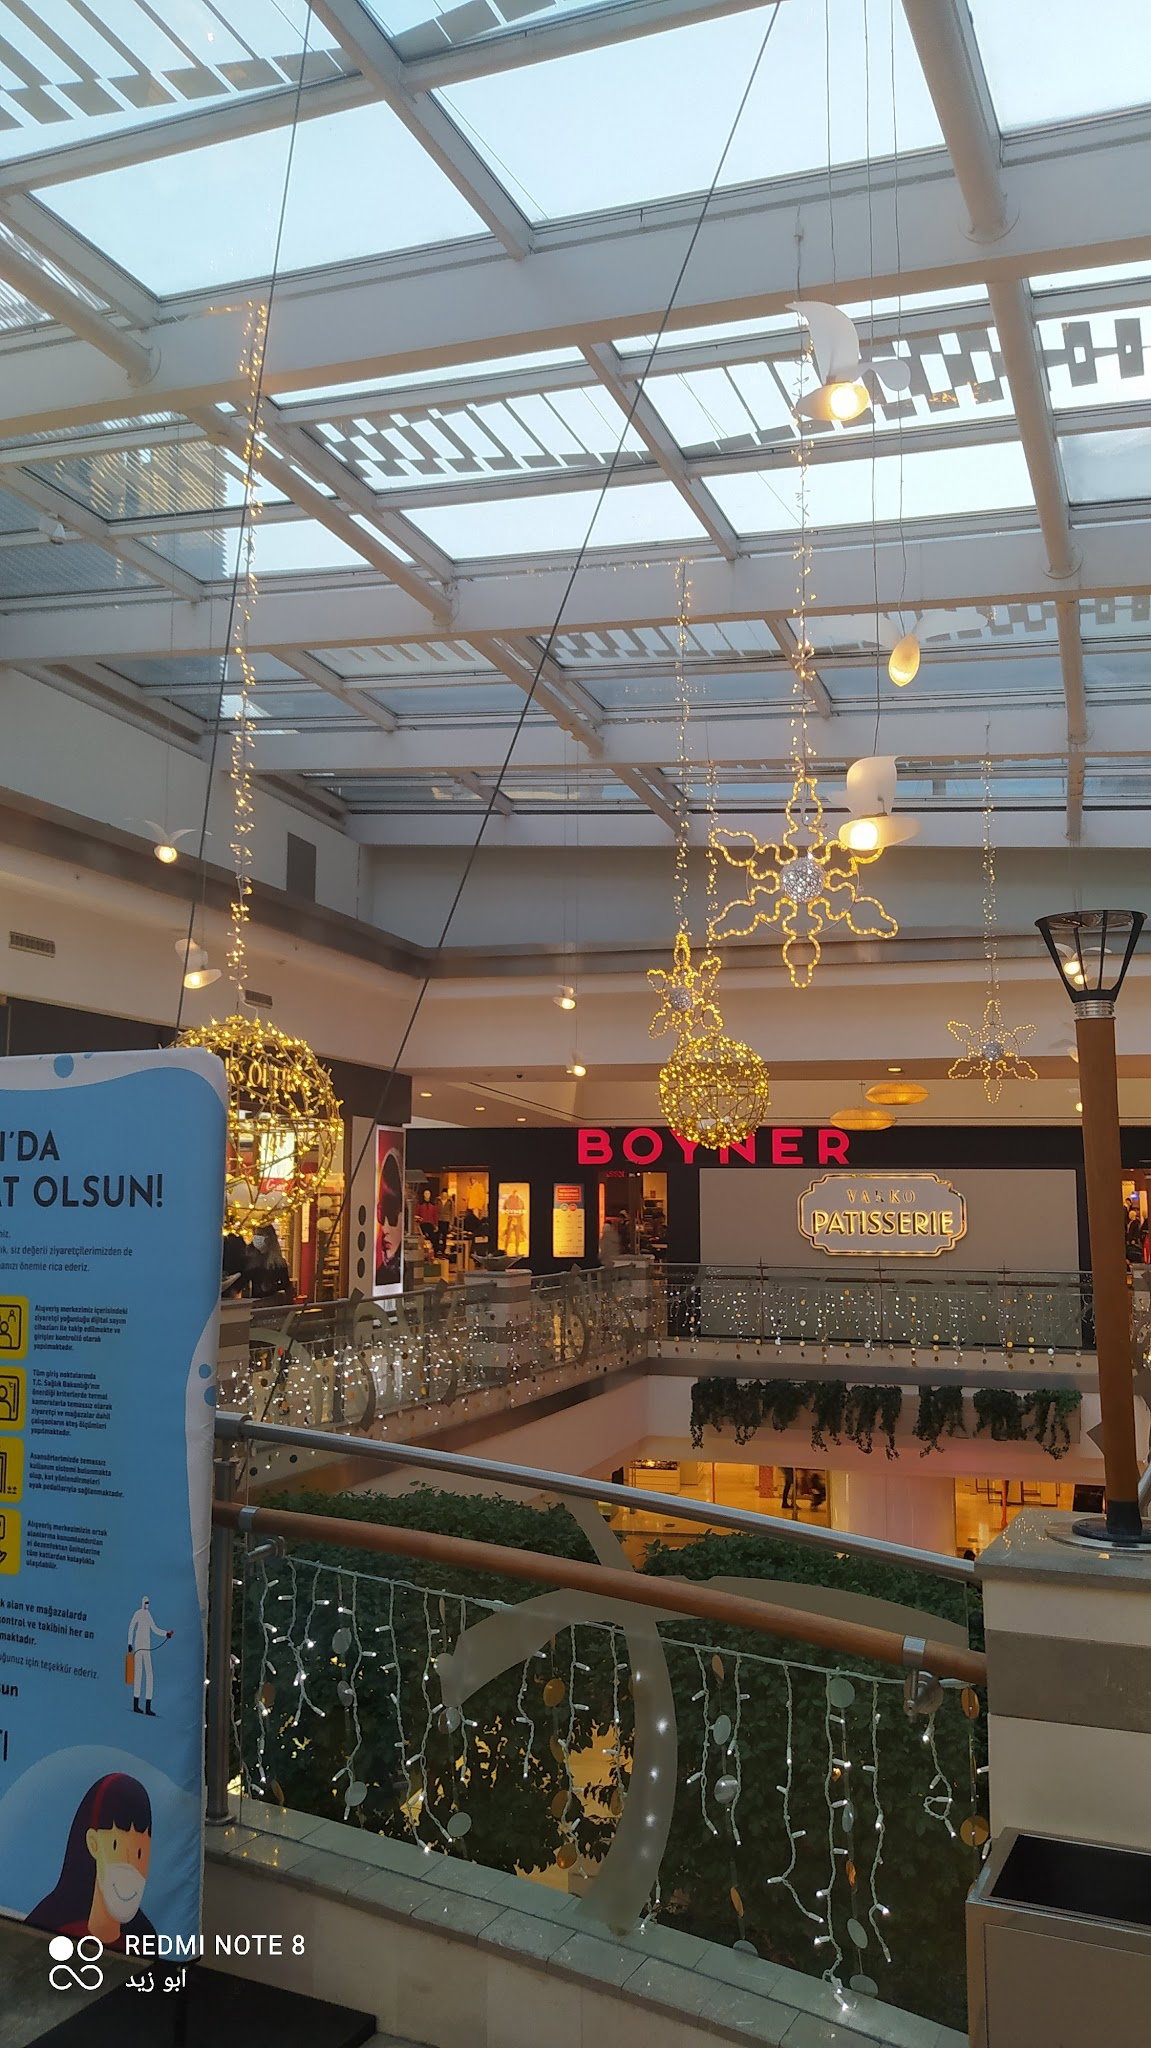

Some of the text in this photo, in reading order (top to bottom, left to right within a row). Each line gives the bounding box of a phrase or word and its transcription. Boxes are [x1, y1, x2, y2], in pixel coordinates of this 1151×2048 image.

[577, 1127, 850, 1165] BOYNER
[33, 1174, 163, 1208] OLSUN!
[812, 1210, 954, 1237] PATISSERIE
[11, 1246, 20, 1254] siz
[22, 1246, 47, 1256] değerli
[50, 1246, 121, 1257] ziyaretçilerimizden
[124, 1248, 133, 1256] de
[20, 1262, 46, 1271] önemle
[7, 1600, 23, 1611] alan
[26, 1604, 34, 1612] ve
[37, 1605, 87, 1621] mağazalarda
[27, 1621, 36, 1629] ve
[38, 1622, 67, 1635] takibini
[69, 1626, 82, 1637] her
[85, 1631, 94, 1639] an
[26, 1656, 39, 1668] için
[41, 1660, 71, 1673] teşekkür
[0, 1684, 18, 1696] un
